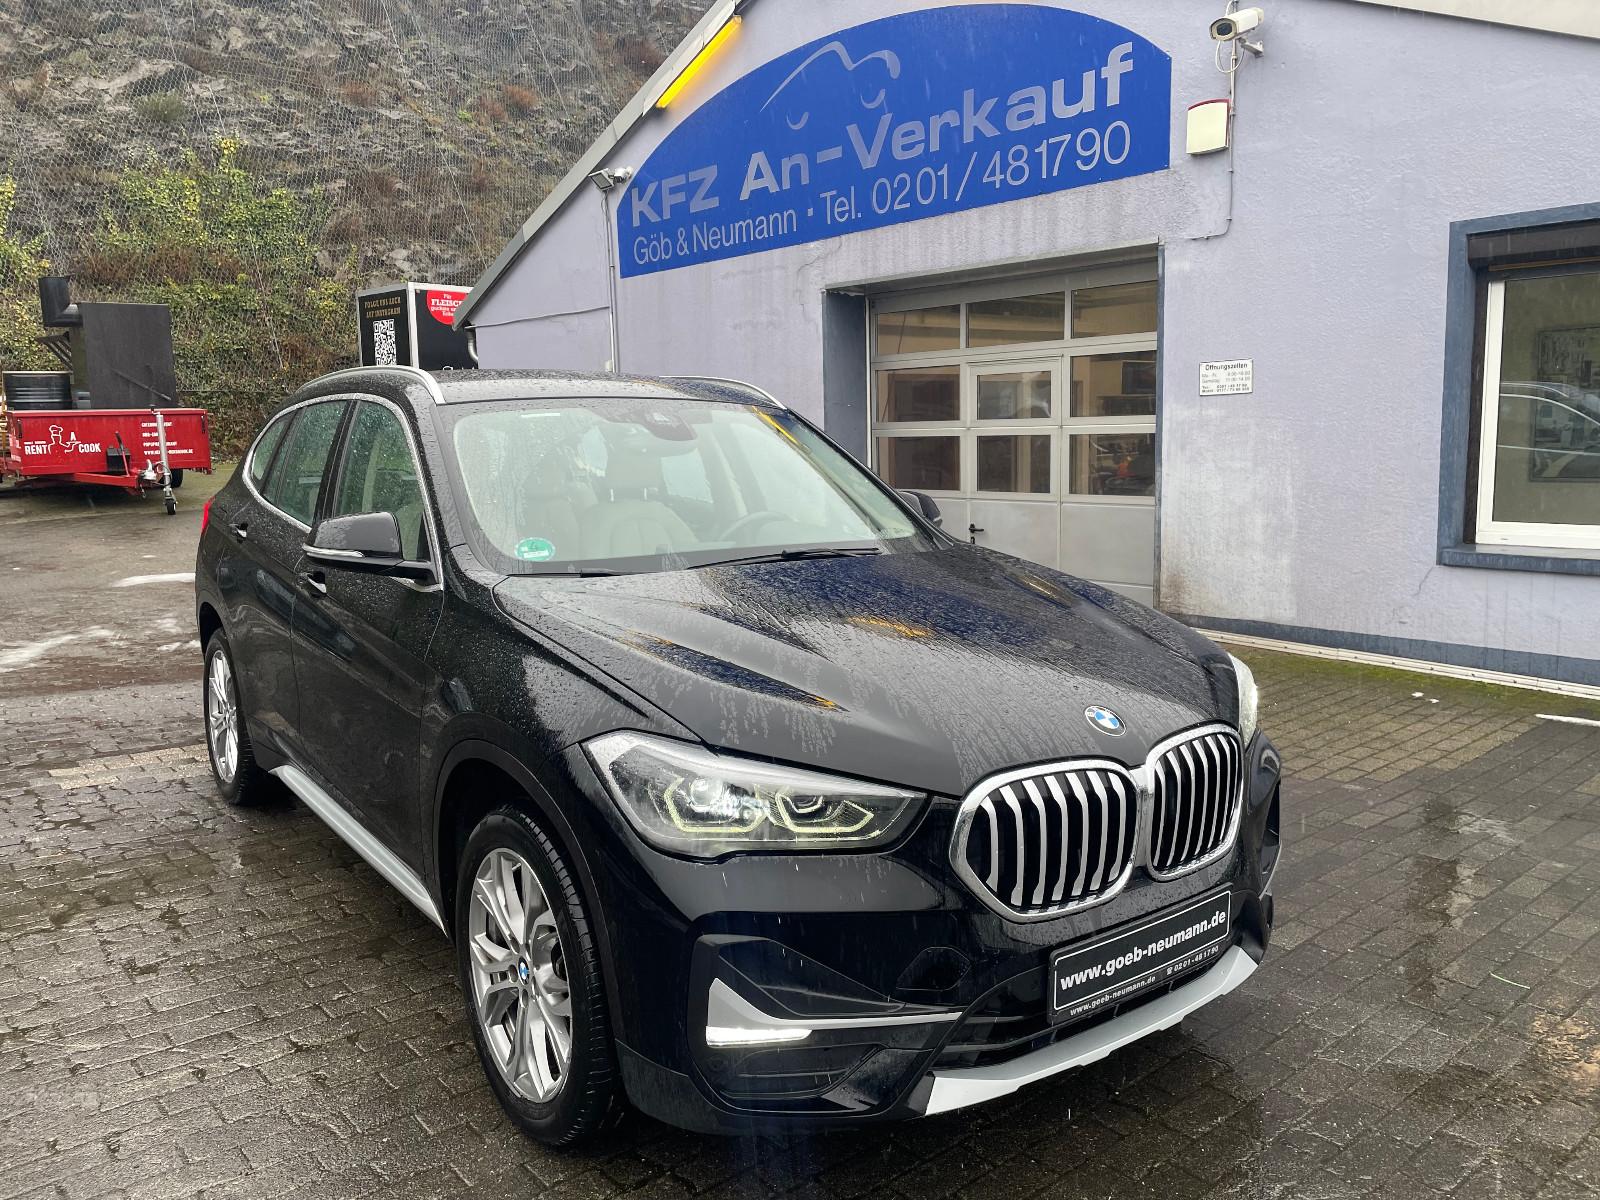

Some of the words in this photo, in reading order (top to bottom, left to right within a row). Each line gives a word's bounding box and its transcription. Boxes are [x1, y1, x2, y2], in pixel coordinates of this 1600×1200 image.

[631, 164, 720, 227] KFZ
[739, 41, 1134, 201] An-Verkauf
[633, 233, 672, 265] Göb
[676, 227, 690, 256] &
[692, 208, 797, 253] Neumann
[819, 189, 862, 225] Tel.
[24, 444, 48, 456] RENT
[78, 442, 102, 453] COOK
[1060, 910, 1226, 991] www.goeb-neumann.de
[1070, 976, 1156, 1016] www.goeb-neumann.de
